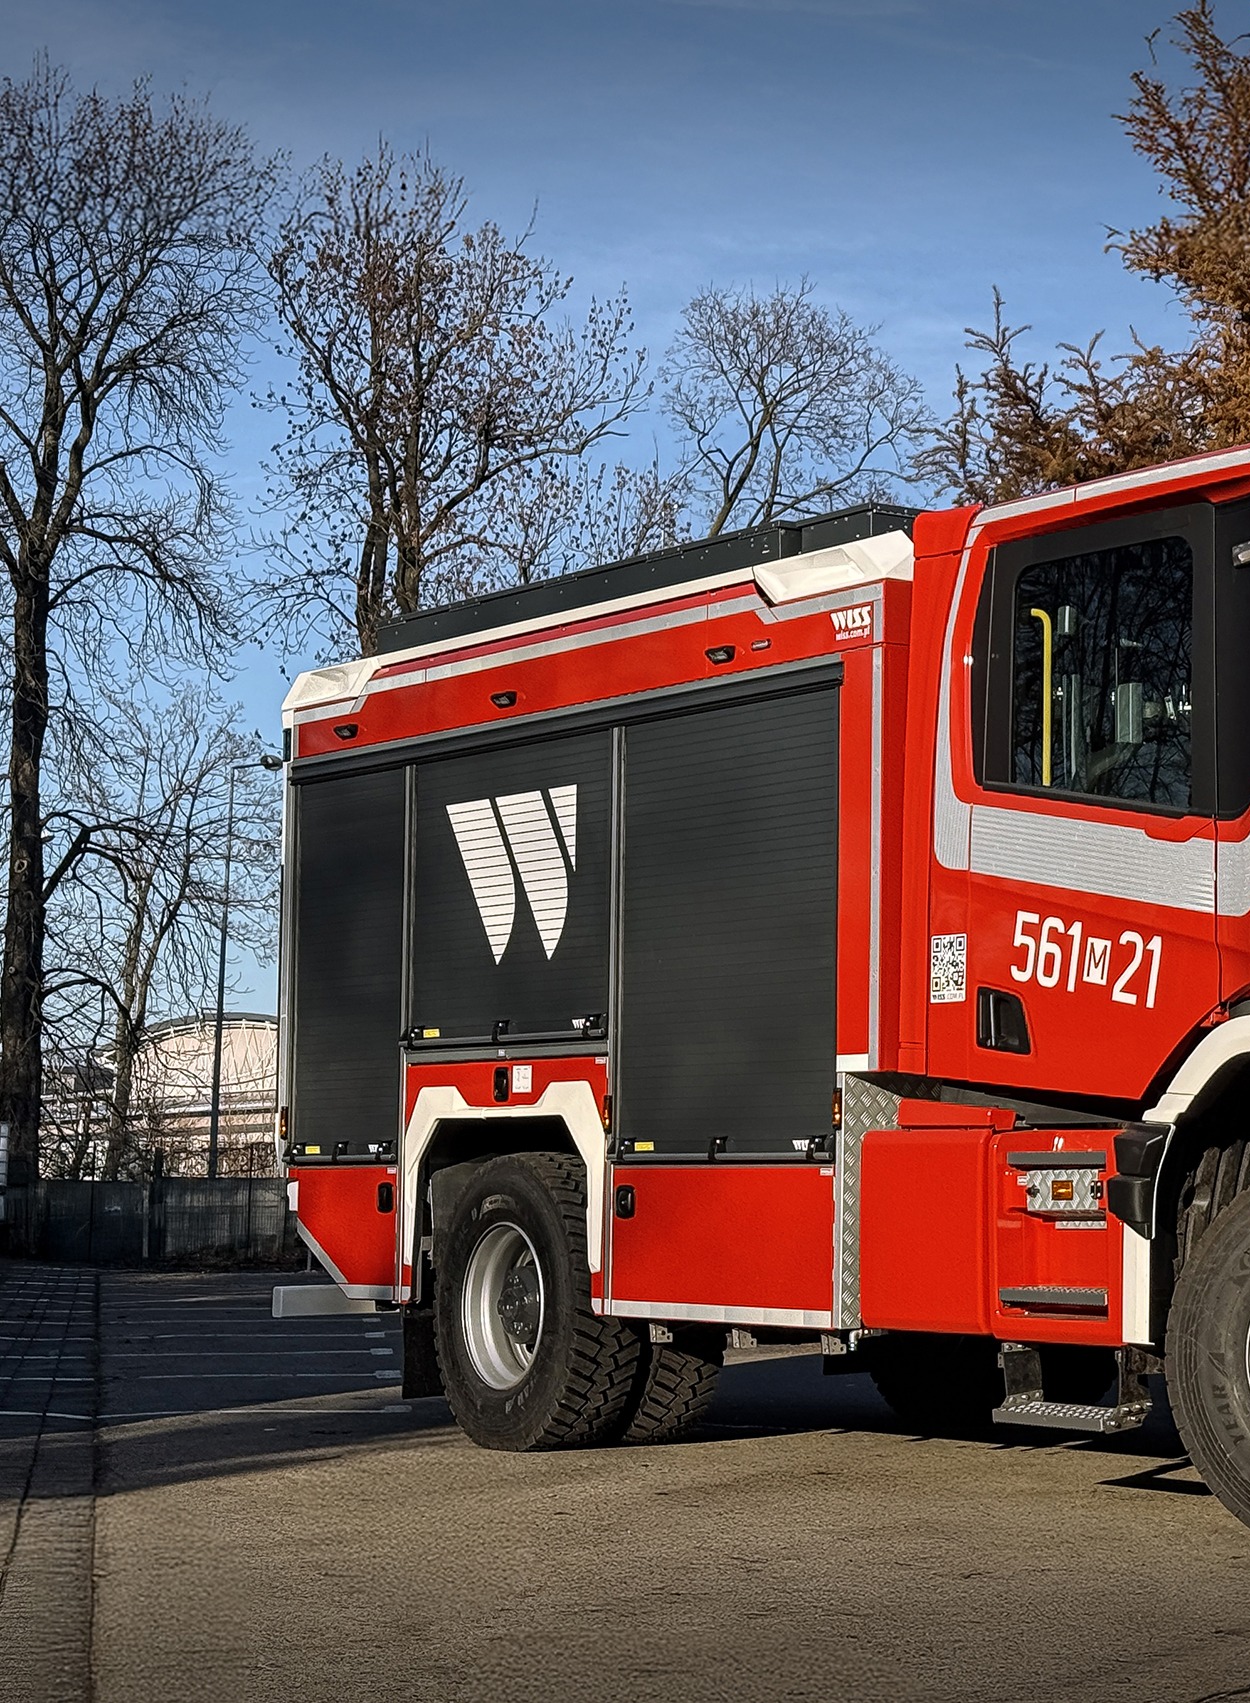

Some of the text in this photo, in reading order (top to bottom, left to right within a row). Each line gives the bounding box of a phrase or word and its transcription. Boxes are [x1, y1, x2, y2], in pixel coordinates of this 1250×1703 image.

[830, 605, 871, 631] WISS
[835, 625, 870, 641] wiss.com.pl
[445, 784, 577, 965] W
